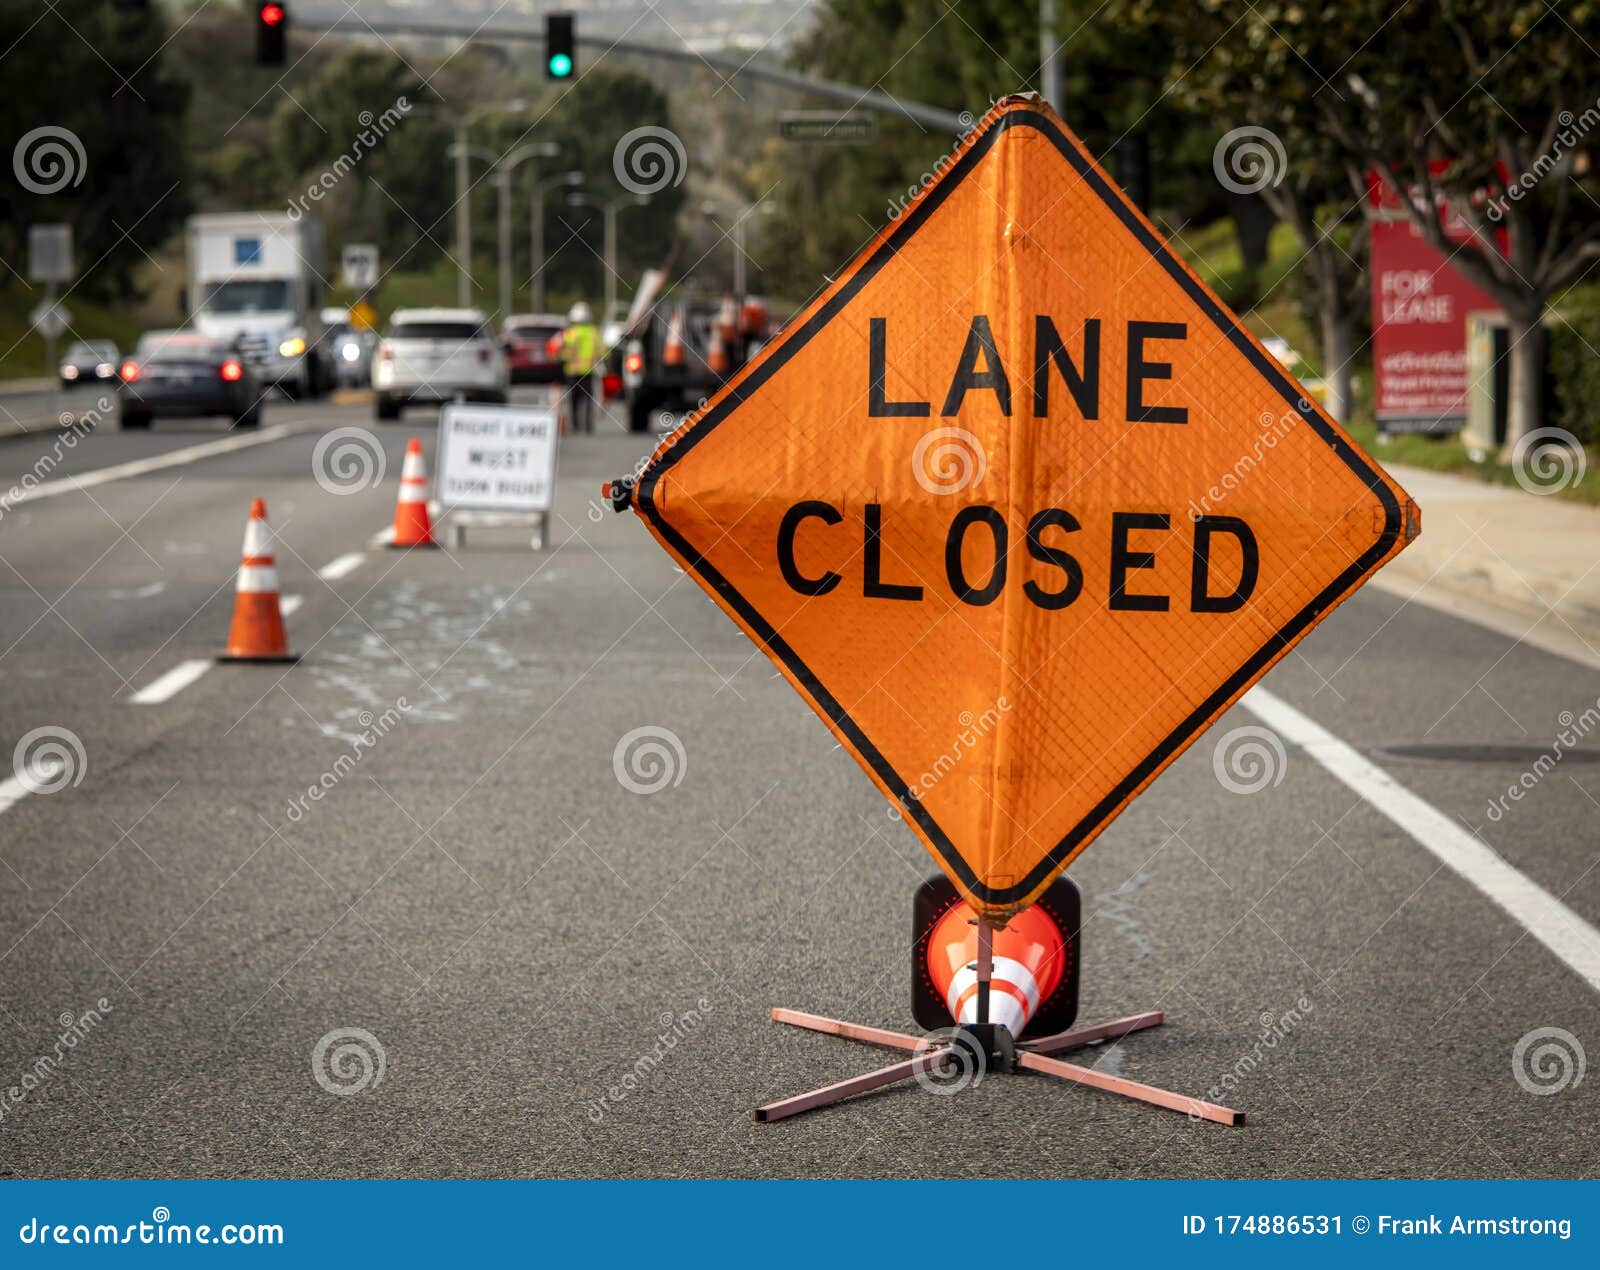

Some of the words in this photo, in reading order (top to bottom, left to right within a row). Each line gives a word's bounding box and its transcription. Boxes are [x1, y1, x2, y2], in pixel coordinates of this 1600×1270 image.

[1381, 270, 1432, 296] FOR
[1382, 296, 1452, 323] LEASE
[868, 316, 1188, 424] LANE
[776, 500, 1260, 614] CLOSED
